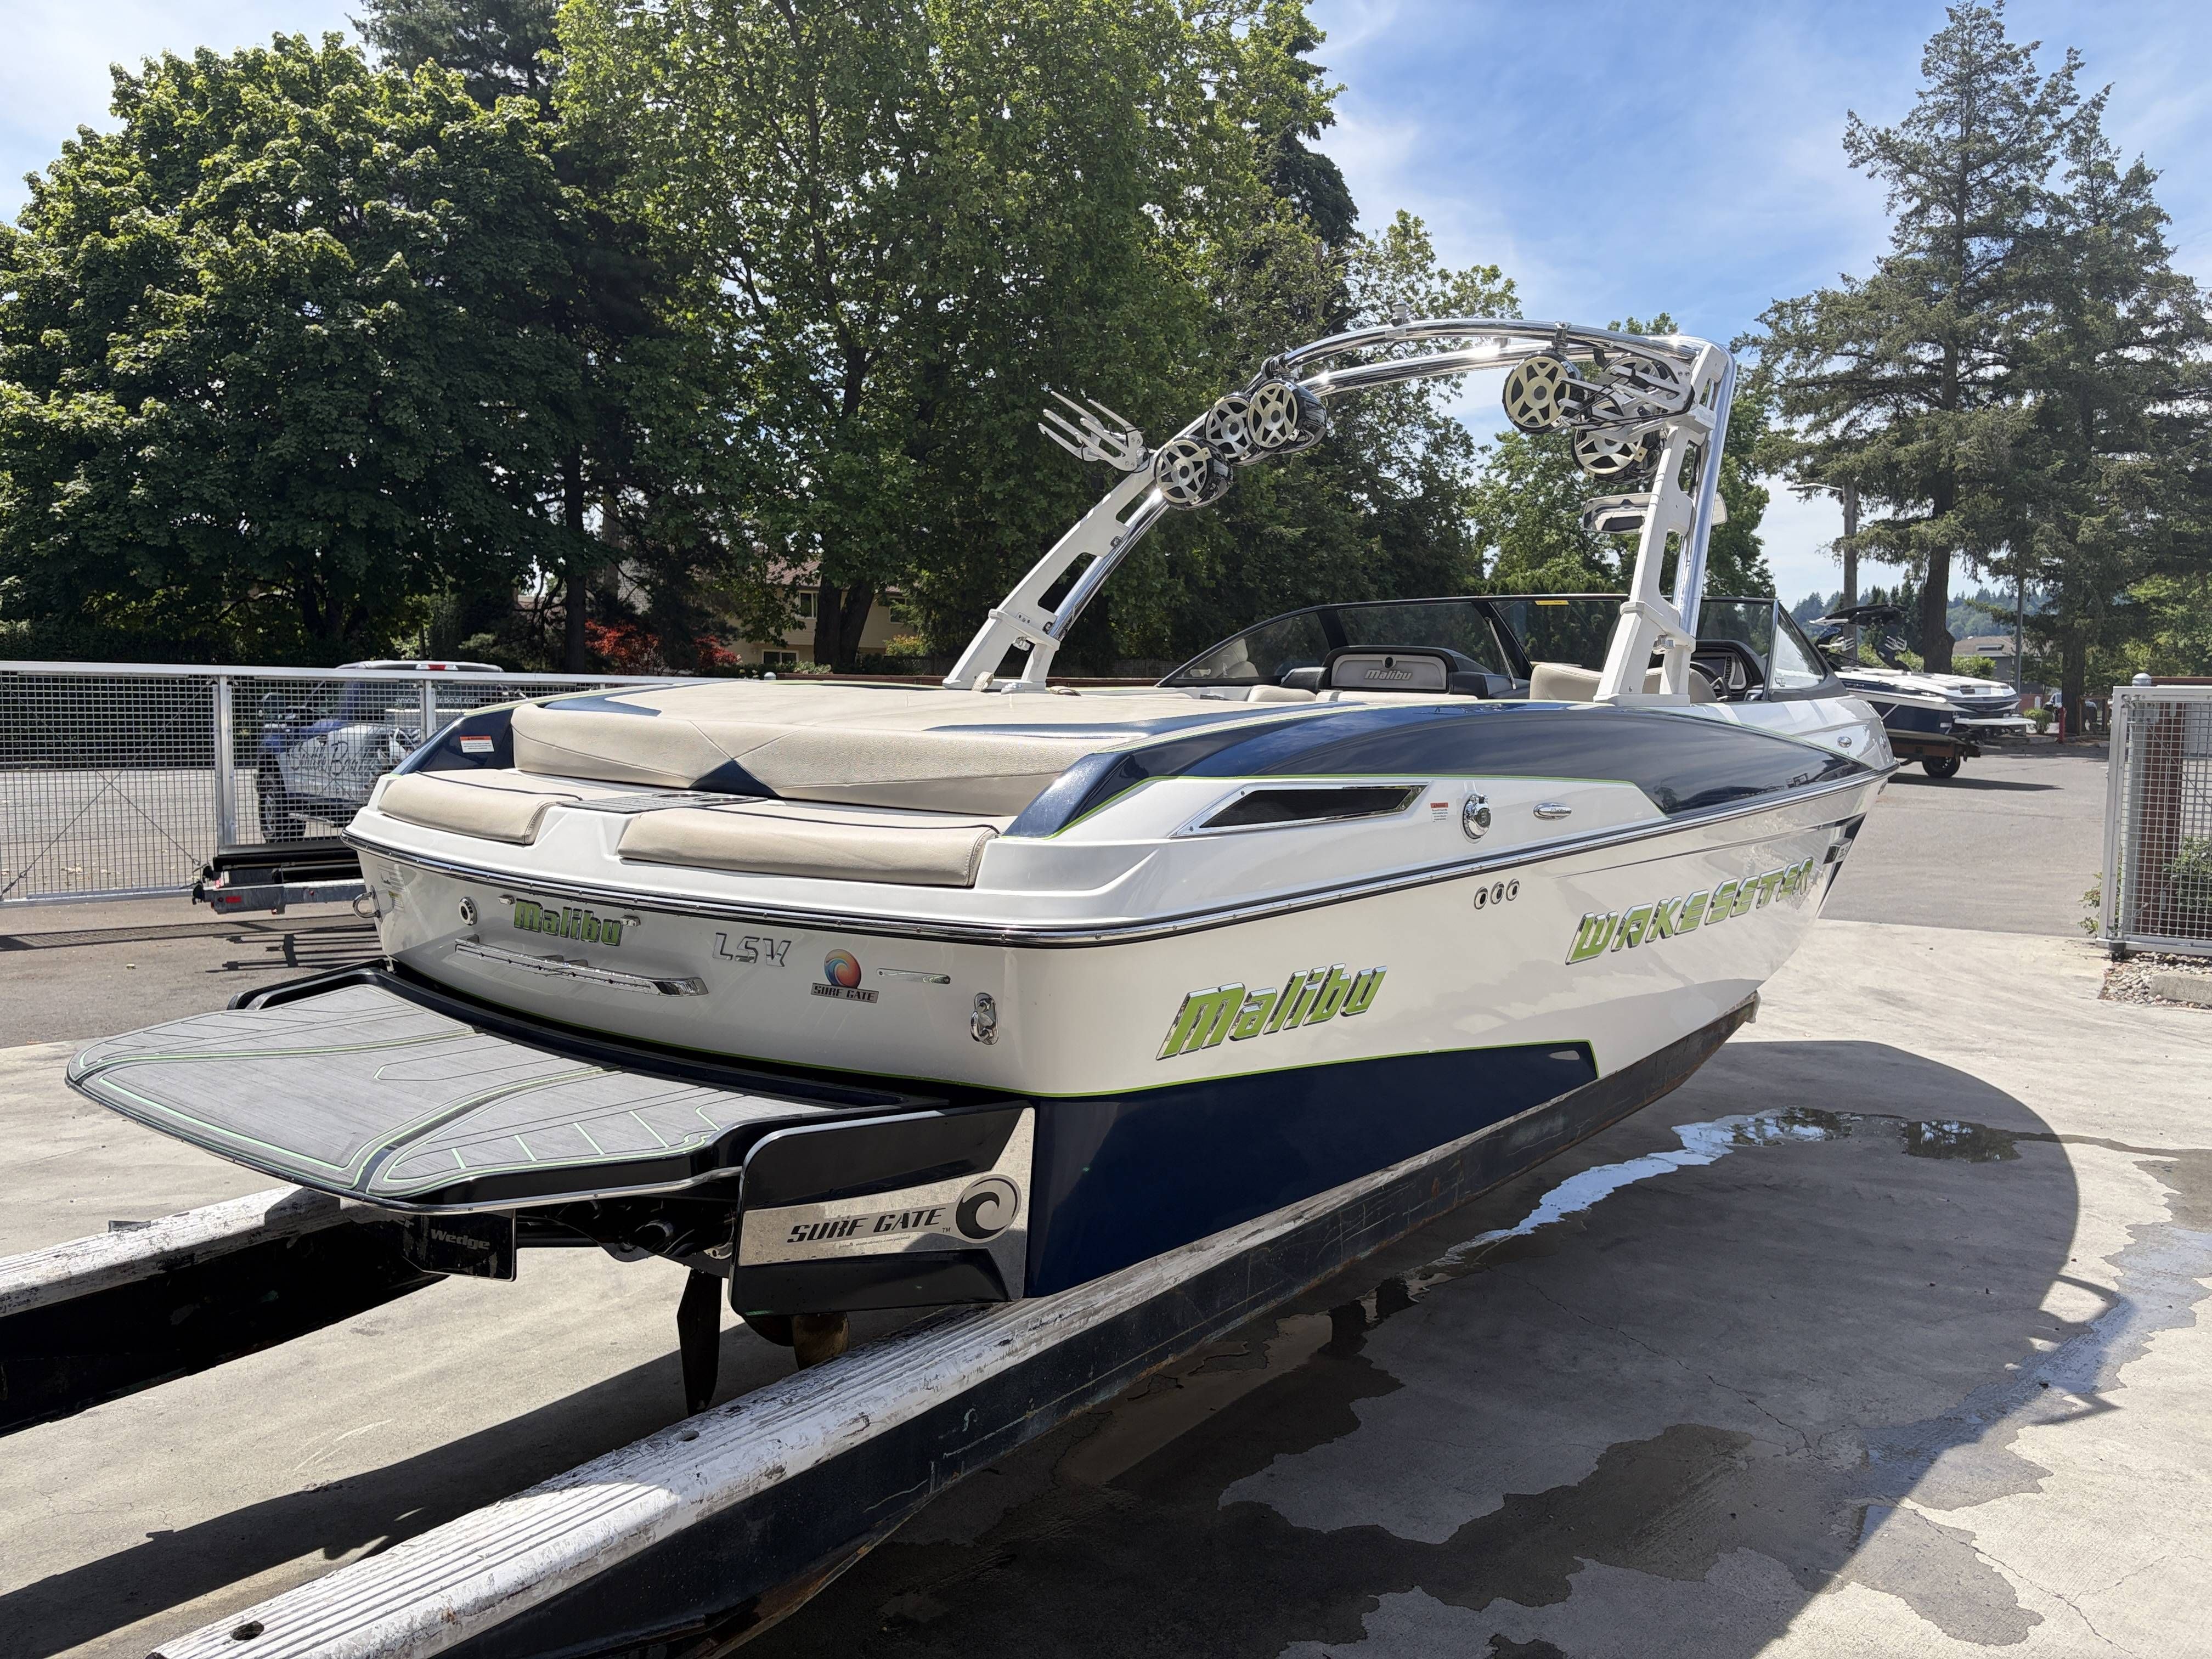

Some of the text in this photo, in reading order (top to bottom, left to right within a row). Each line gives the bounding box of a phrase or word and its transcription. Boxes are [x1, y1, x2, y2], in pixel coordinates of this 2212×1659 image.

[1364, 669, 1413, 680] Malibu
[514, 898, 623, 947] Malibu
[712, 932, 792, 967] LSV
[813, 985, 876, 1001] SURF GATE
[1155, 962, 1388, 1061] Malibu
[430, 1228, 490, 1251] Wedge
[787, 1217, 868, 1243] SURF
[873, 1207, 946, 1233] GATE
